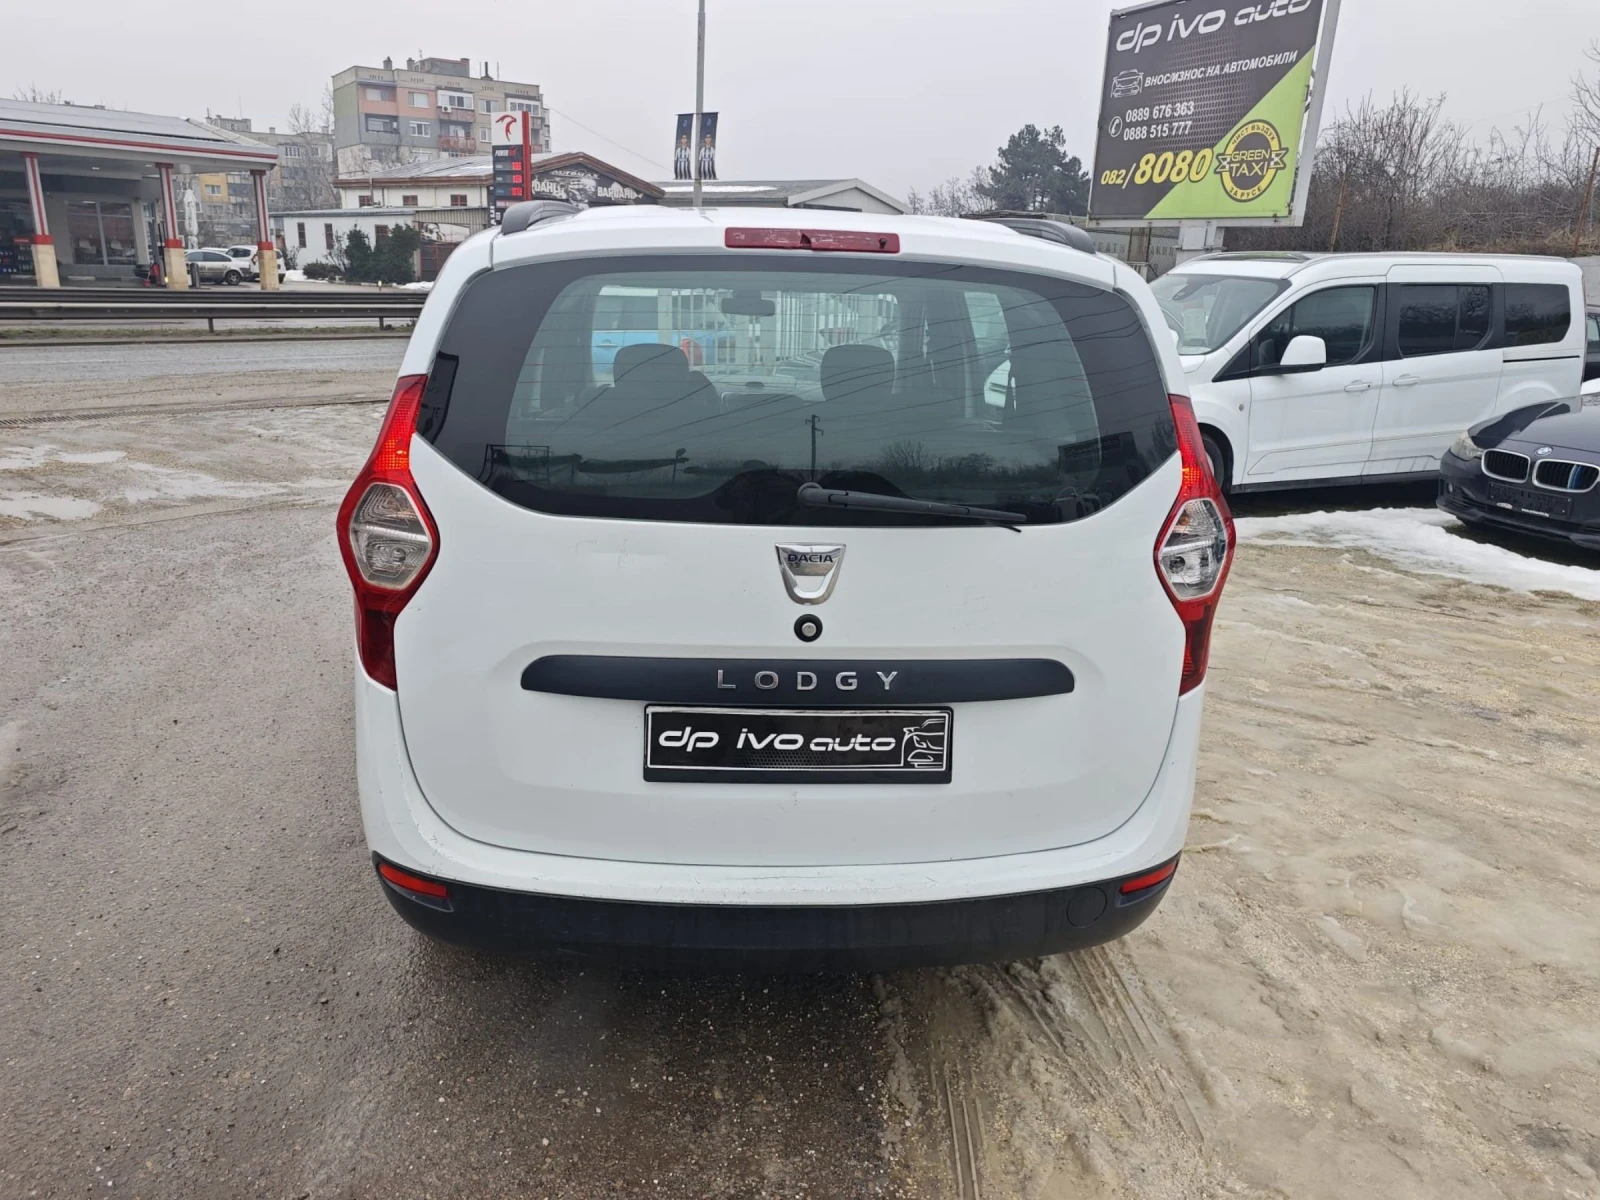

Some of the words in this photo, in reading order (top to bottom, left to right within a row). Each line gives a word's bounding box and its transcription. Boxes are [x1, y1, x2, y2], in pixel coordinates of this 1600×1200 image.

[1116, 22, 1162, 53] dp
[1167, 9, 1226, 41] ivo
[1233, 0, 1311, 26] auto
[1206, 65, 1221, 77] НА
[1222, 50, 1298, 74] АВТОМОБИЛИ
[1125, 107, 1149, 123] 0889
[1152, 104, 1172, 119] 676
[1173, 101, 1194, 117] 363
[1123, 125, 1147, 141] 0888
[1149, 122, 1168, 138] 515
[1171, 120, 1192, 136] 777
[1232, 127, 1249, 145] ЧИСТ
[1251, 124, 1276, 142] ВЪЗДУХ
[1231, 149, 1270, 162] GREEN
[1230, 161, 1268, 177] TAXI
[1229, 186, 1238, 197] ЗА
[1240, 186, 1262, 198] РУСЕ
[787, 554, 834, 563] DACIA
[717, 669, 898, 691] LODGY
[658, 727, 719, 752] dp
[736, 728, 804, 750] ivo
[809, 734, 897, 752] auto
